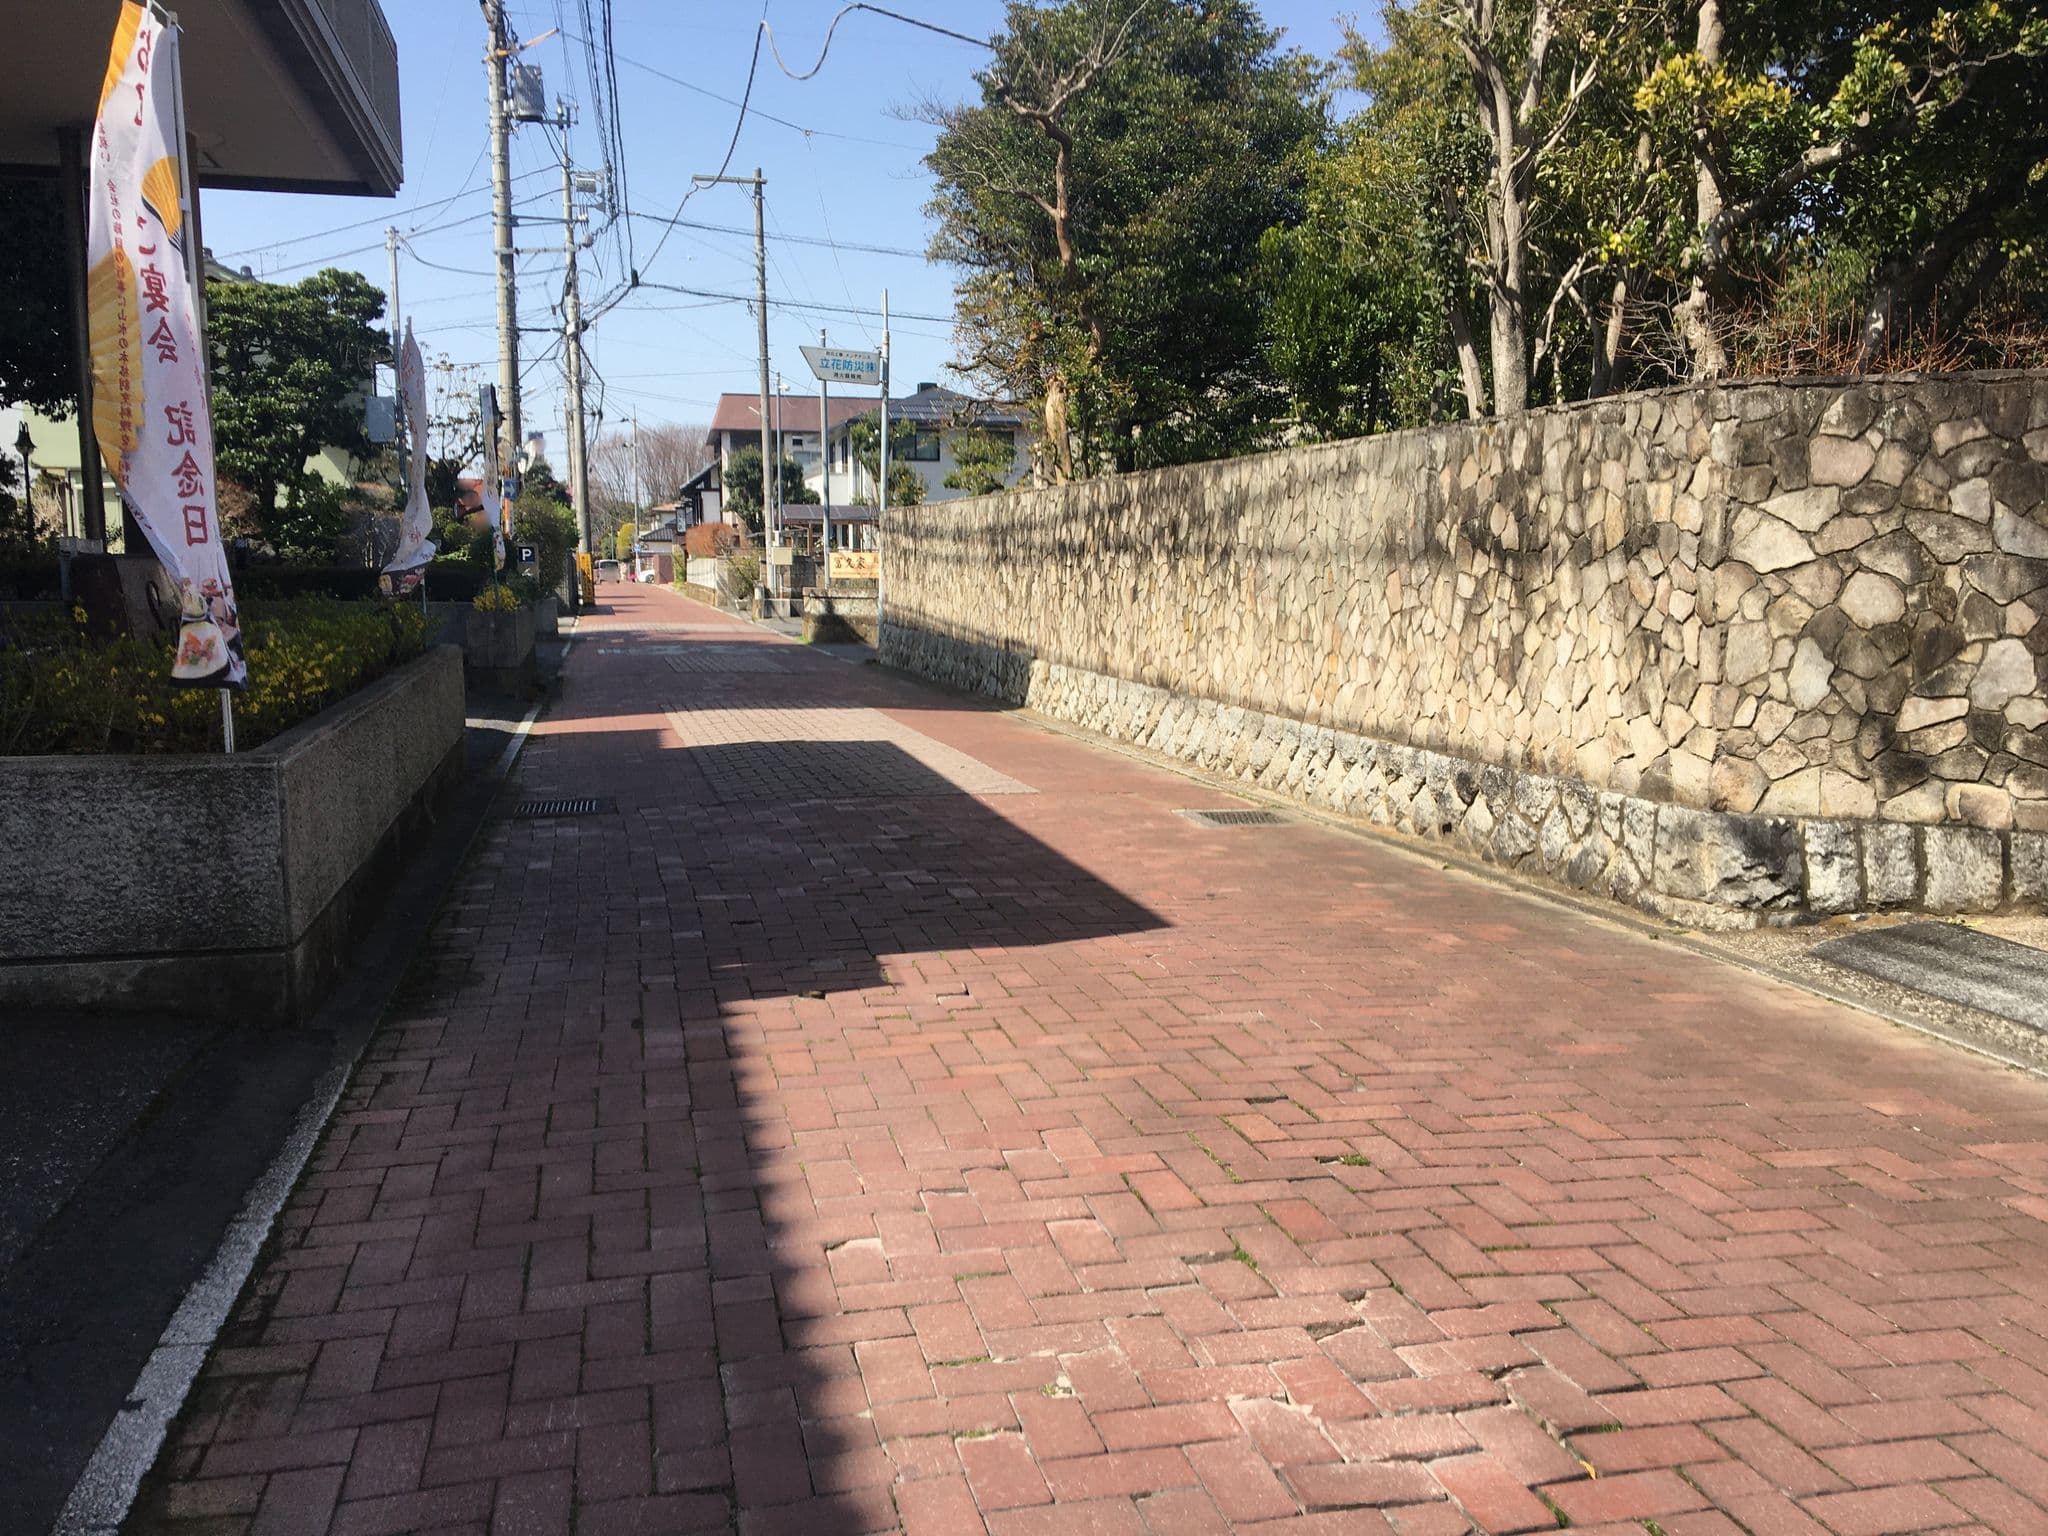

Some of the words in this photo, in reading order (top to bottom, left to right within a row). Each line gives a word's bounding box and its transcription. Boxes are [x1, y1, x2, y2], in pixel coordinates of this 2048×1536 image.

[164, 399, 209, 548] 記念日
[522, 548, 533, 561] P
